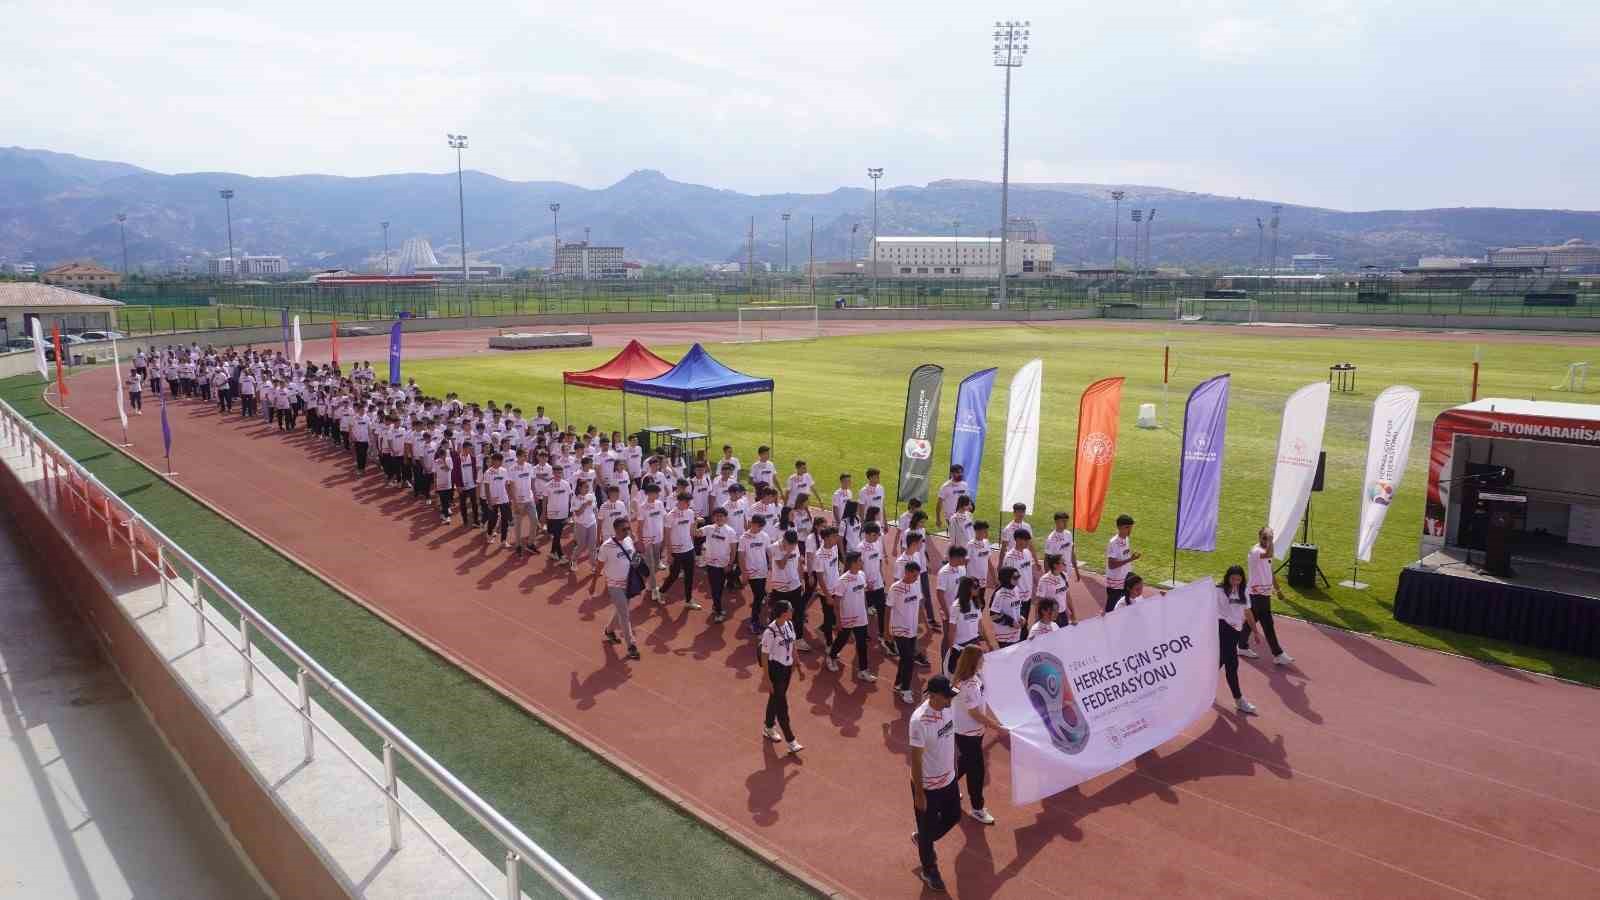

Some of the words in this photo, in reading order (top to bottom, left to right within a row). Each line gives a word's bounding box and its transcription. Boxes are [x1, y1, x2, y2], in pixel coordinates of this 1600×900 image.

[1073, 661, 1122, 693] HERKES
[1152, 635, 1193, 661] SPOR
[1081, 661, 1177, 712] FEDERASYONU
